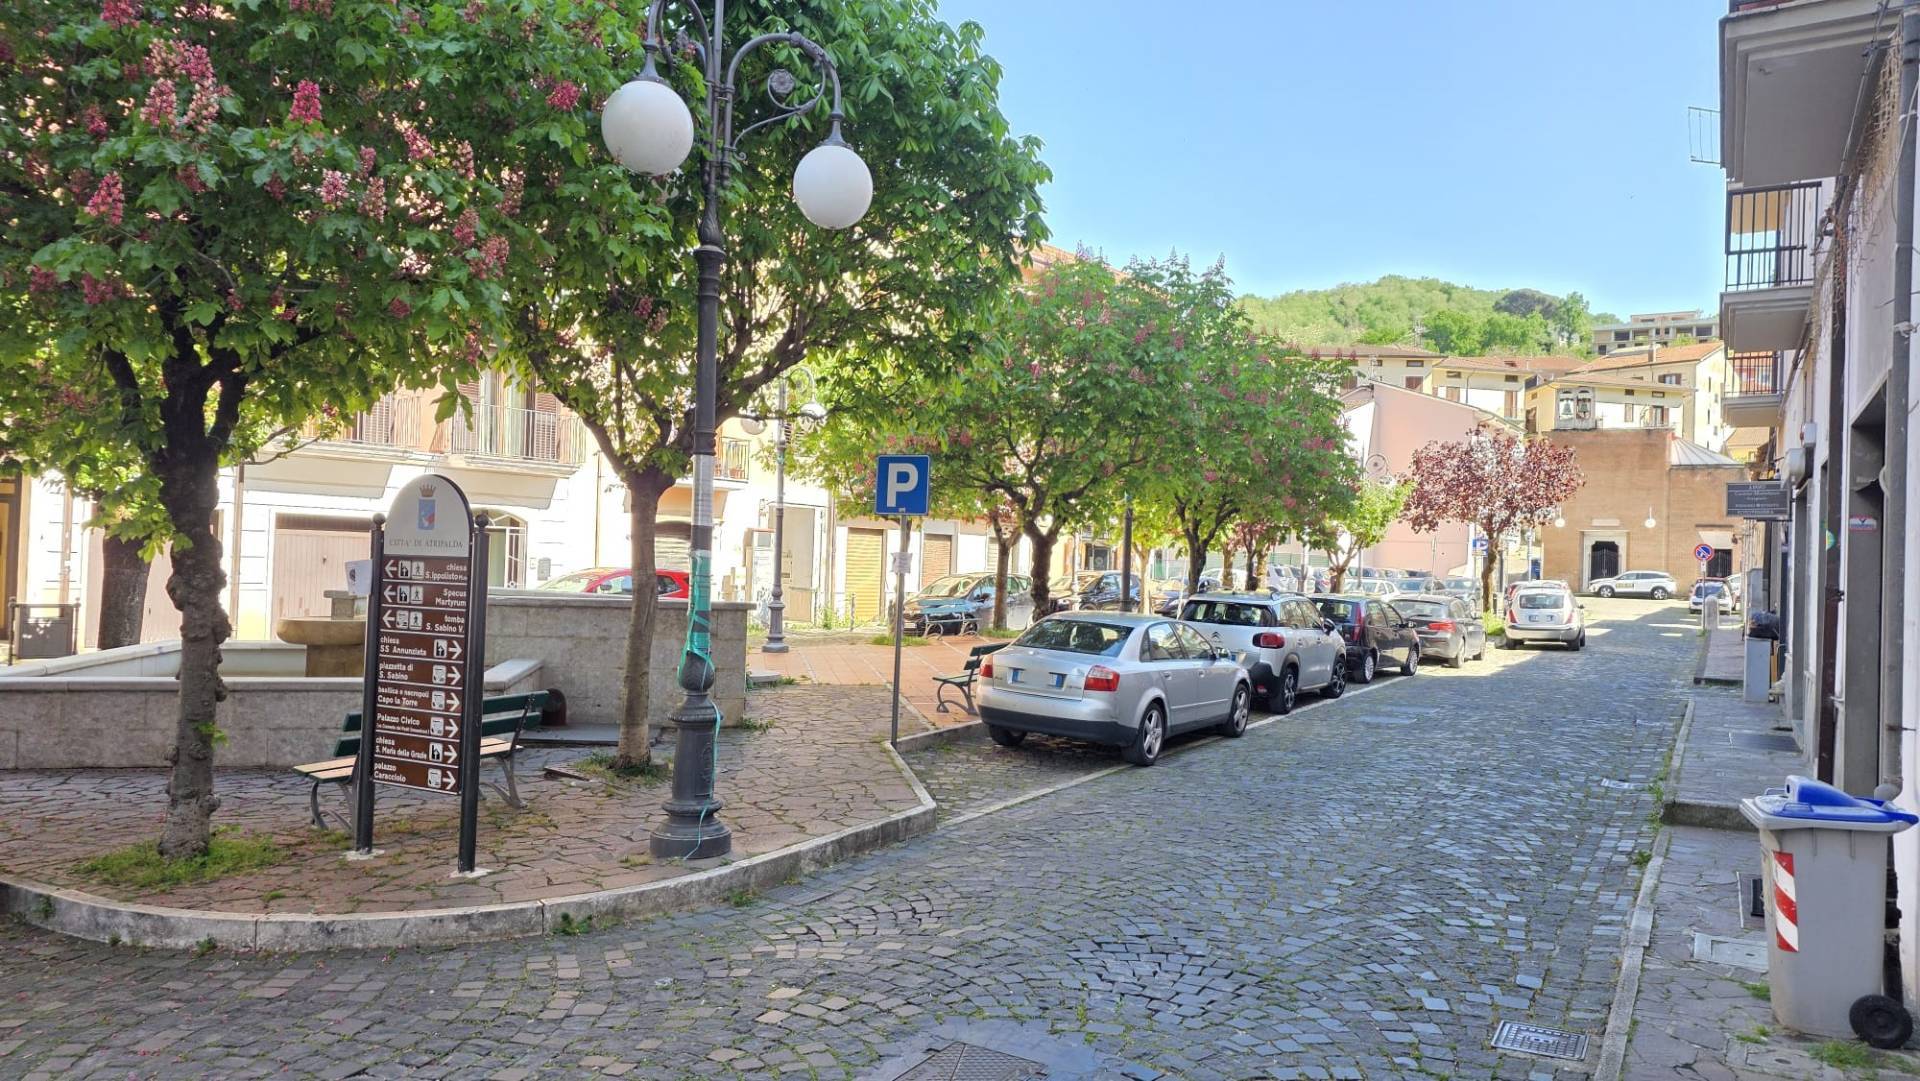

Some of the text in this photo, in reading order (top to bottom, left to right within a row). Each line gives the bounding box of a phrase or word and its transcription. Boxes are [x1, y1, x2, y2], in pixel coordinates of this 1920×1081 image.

[887, 463, 918, 507] P
[426, 540, 464, 549] ATRIPALDA
[447, 563, 467, 571] chiesa
[443, 588, 467, 598] Specus
[435, 597, 467, 607] Martyrum
[444, 614, 465, 623] tomba
[434, 623, 457, 632] Sabino
[380, 636, 400, 645] chiesa
[392, 646, 427, 656] Annunziata
[387, 671, 409, 681] Sabino
[378, 695, 394, 705] Capo
[401, 698, 418, 707] Torre
[377, 713, 421, 726] Palazzo Civico
[375, 736, 396, 746] chiesa
[374, 762, 397, 772] palazzo
[373, 771, 407, 783] Caracciolo
